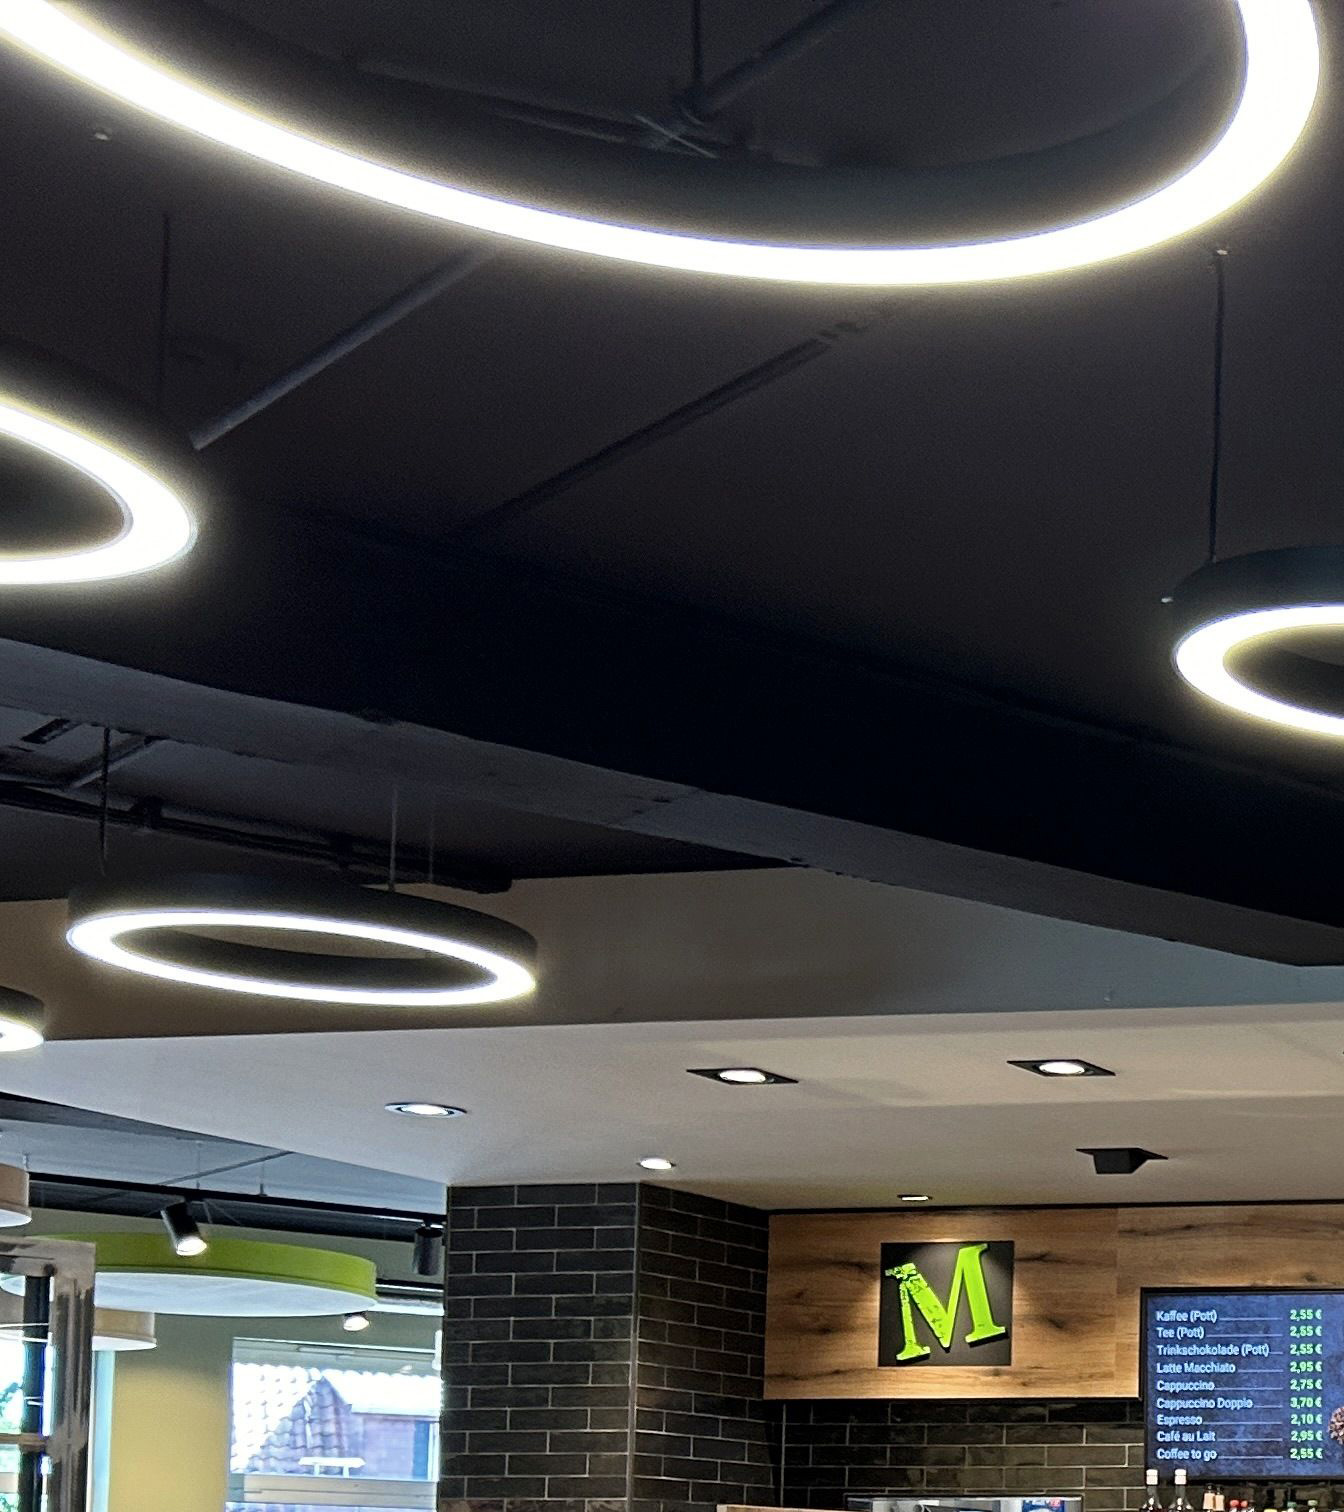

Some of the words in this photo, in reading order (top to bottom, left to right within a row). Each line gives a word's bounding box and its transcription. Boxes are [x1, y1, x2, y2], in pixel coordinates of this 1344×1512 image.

[885, 1244, 1006, 1361] M
[1156, 1310, 1188, 1321] Kaffee
[1190, 1309, 1217, 1323] (Pott)
[1290, 1309, 1314, 1321] 2,55
[1156, 1327, 1174, 1338] Tee
[1176, 1326, 1204, 1340] (Pott)
[1156, 1345, 1239, 1356] Trinkschokolade
[1241, 1344, 1269, 1357] (Pott)
[1156, 1363, 1183, 1374] Latte
[1184, 1362, 1236, 1374] Macchiato
[1156, 1380, 1215, 1393] Cappuccino
[1290, 1379, 1314, 1391] 2,75
[1156, 1398, 1215, 1410] Cappuccino
[1217, 1398, 1253, 1410] Doppio
[1290, 1397, 1314, 1409] 3,70
[1156, 1414, 1202, 1426] Espresso
[1290, 1414, 1314, 1426] 2,10
[1156, 1431, 1180, 1442] Café
[1182, 1433, 1195, 1442] au
[1197, 1431, 1216, 1442] Lait
[1290, 1430, 1314, 1442] 2,95
[1156, 1449, 1189, 1460] Coffee
[1191, 1449, 1201, 1460] to
[1203, 1451, 1217, 1462] go
[1290, 1448, 1314, 1460] 2,55
